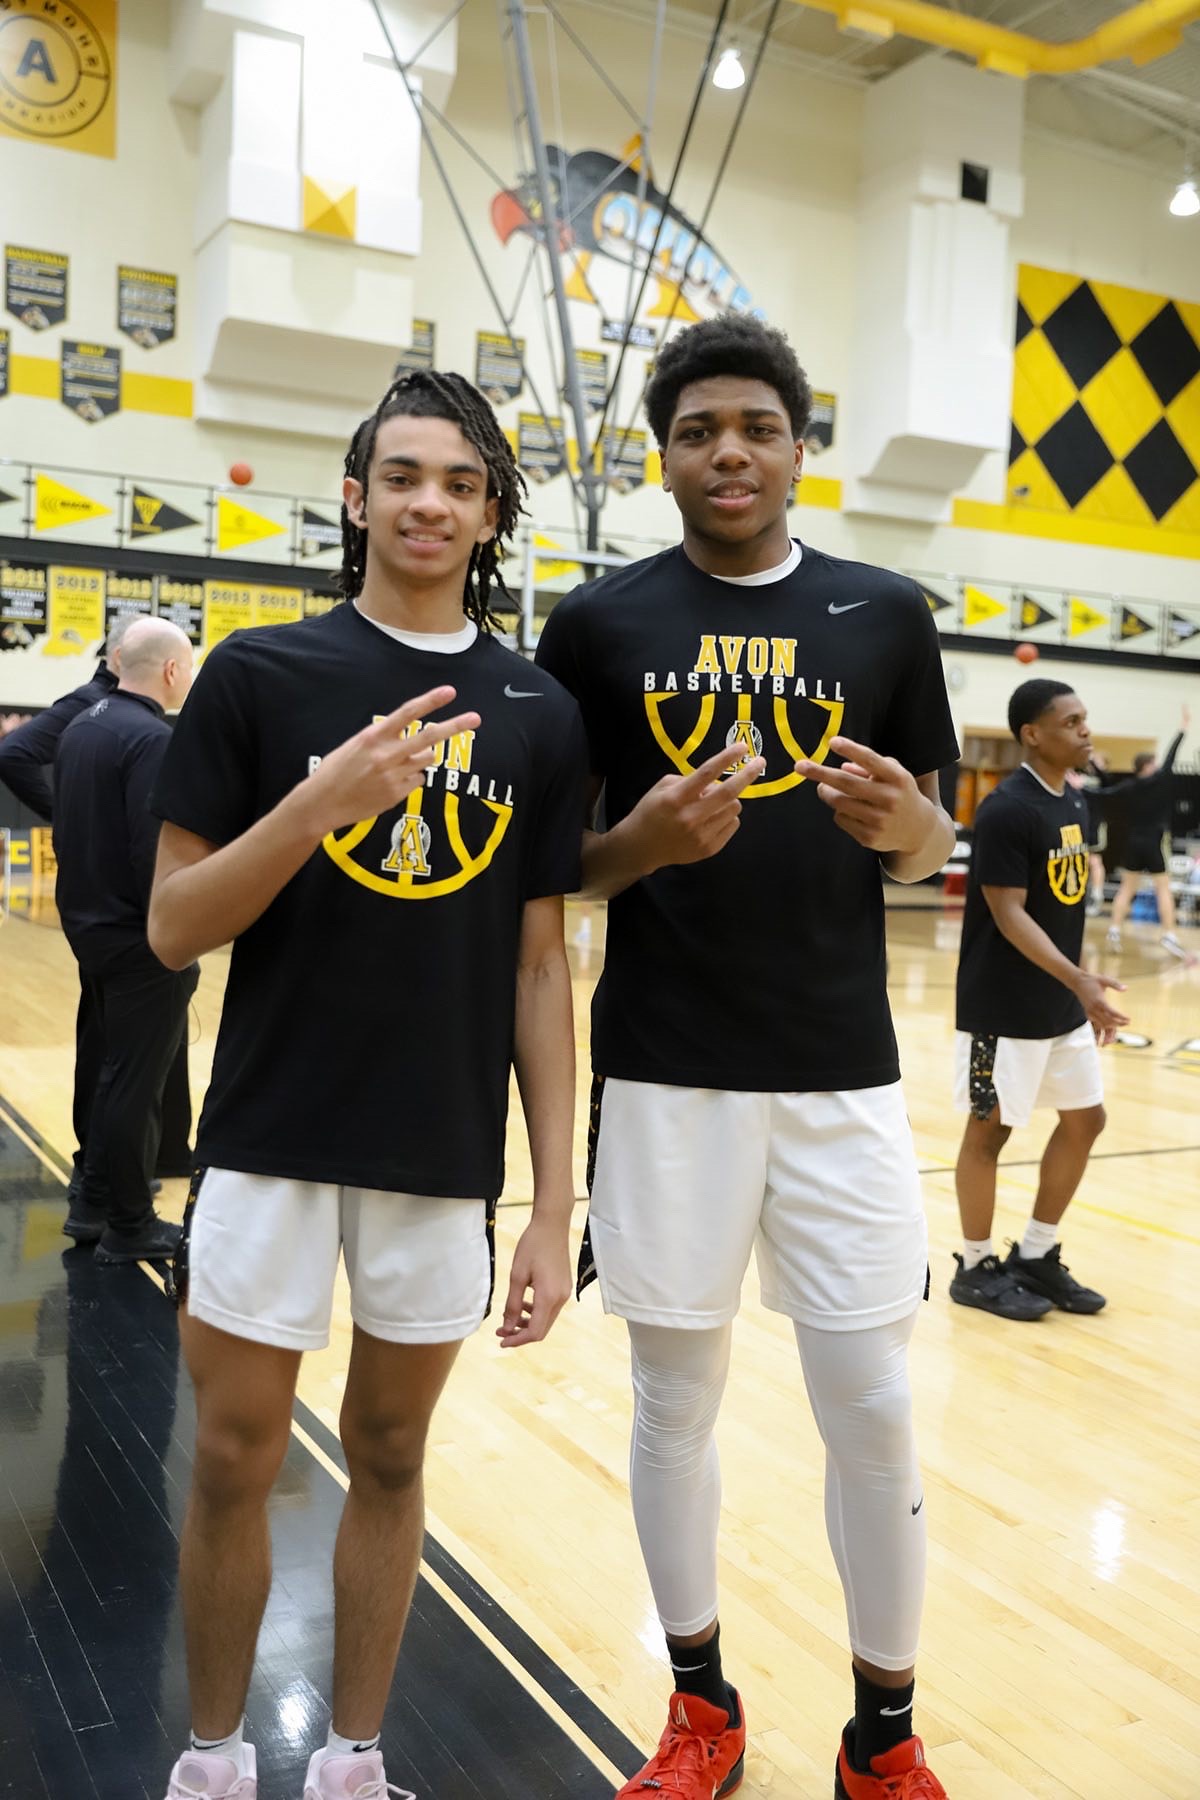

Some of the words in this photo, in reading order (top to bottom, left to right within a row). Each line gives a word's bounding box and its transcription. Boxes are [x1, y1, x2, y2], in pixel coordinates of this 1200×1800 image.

[17, 38, 57, 84] A
[694, 635, 798, 677] AVON
[644, 671, 845, 702] BASKETBALL
[308, 755, 514, 806] BTBALL
[381, 813, 431, 876] A
